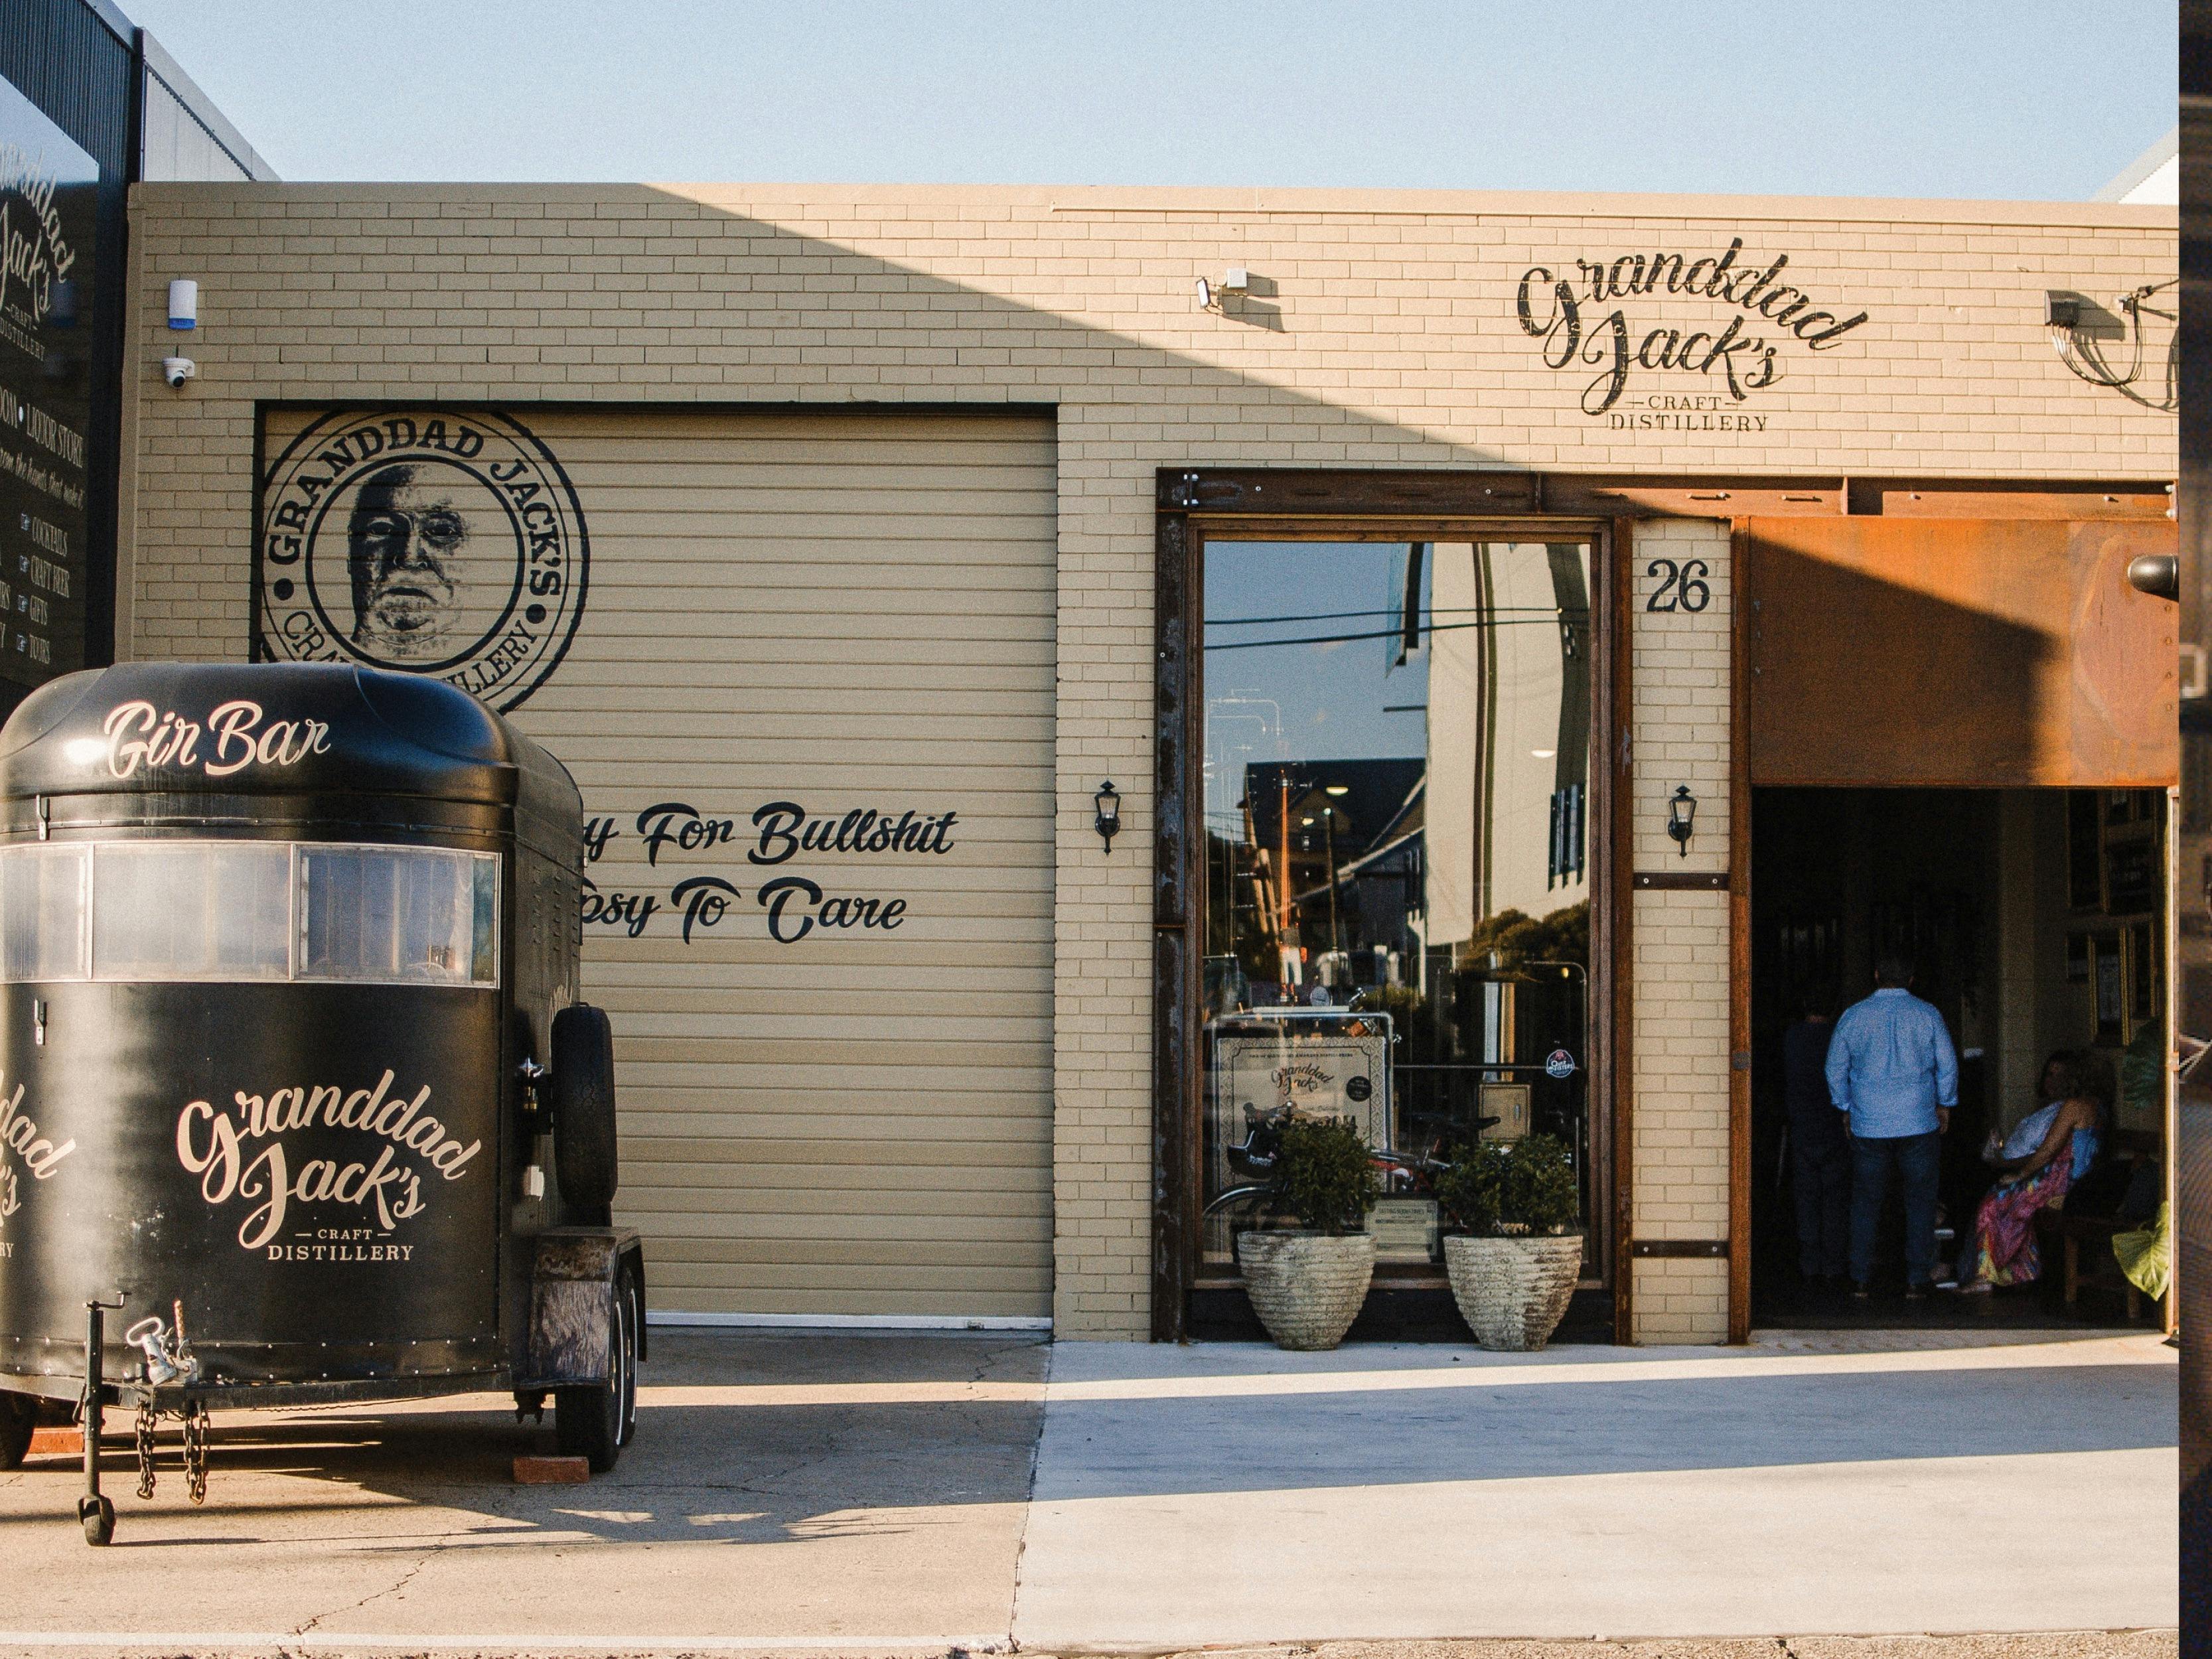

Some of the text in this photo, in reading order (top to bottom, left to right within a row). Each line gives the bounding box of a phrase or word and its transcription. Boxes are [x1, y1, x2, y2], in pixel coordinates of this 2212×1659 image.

[1518, 237, 1868, 369] Granddad
[1582, 310, 1784, 415] Jack's
[1611, 413, 1769, 432] DISTILLERY
[1648, 396, 1722, 410] CRAFT
[27, 403, 56, 453] LIQUOR
[58, 424, 83, 469] STORE
[33, 516, 67, 557] COCKTAILS
[268, 418, 561, 596] GRANDDAD JACK'S
[31, 555, 51, 590] CRAFT
[1647, 559, 1710, 613] 26
[205, 700, 331, 776] Bar
[636, 802, 735, 867] For
[748, 802, 959, 865] Bullshit
[671, 876, 741, 945] To
[758, 876, 907, 944] Care
[176, 1069, 481, 1204] Granddad
[238, 1142, 426, 1250] Jack's
[267, 1244, 414, 1261] DISTILLERY
[317, 1229, 373, 1240] CRAFT
